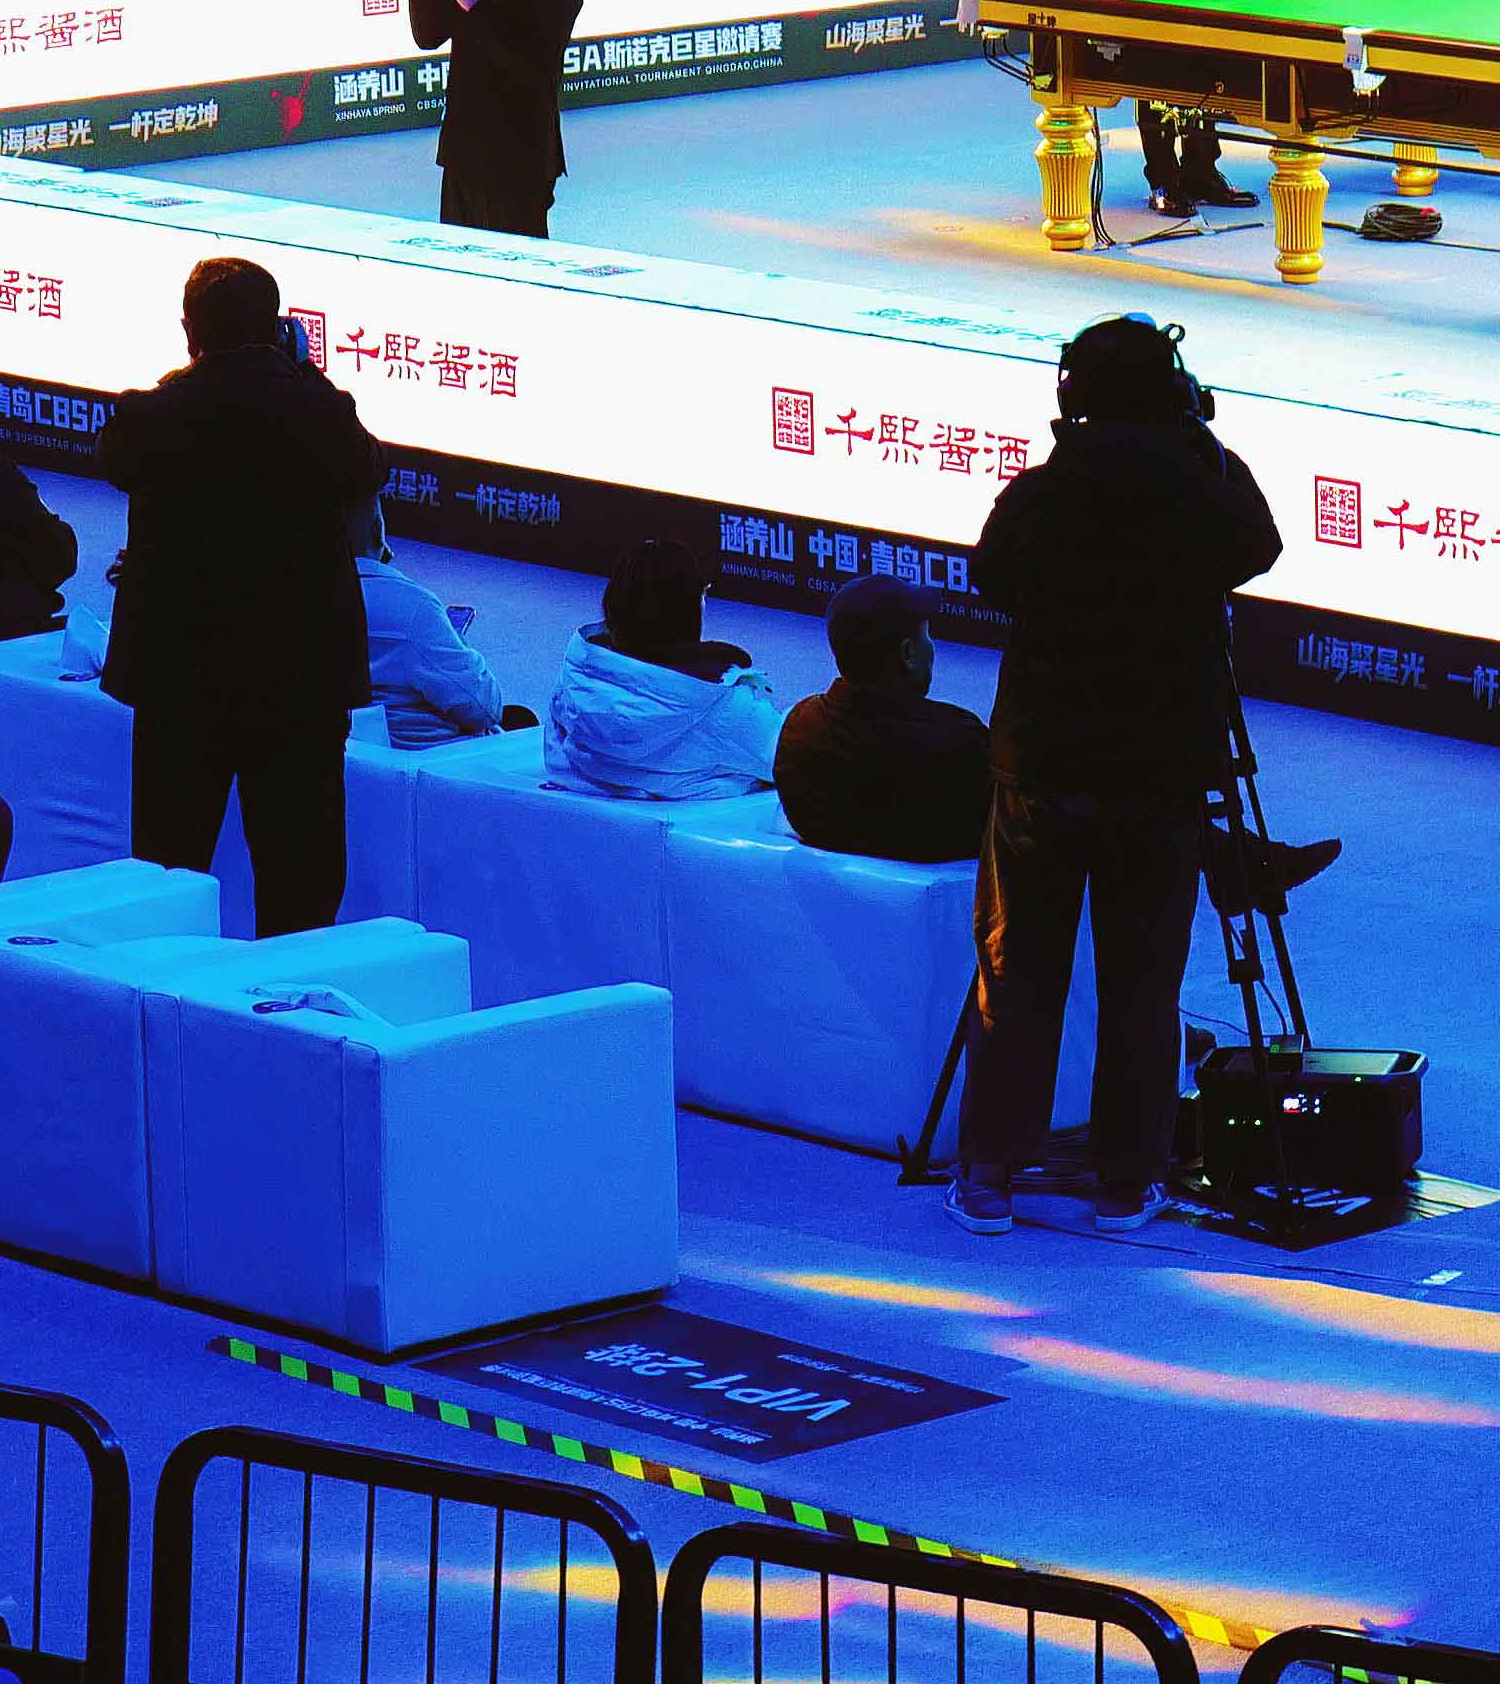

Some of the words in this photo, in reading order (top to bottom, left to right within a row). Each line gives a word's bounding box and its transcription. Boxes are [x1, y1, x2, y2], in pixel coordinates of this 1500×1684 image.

[825, 13, 927, 54] 山海聚星光
[334, 66, 405, 106] 涵养山
[563, 74, 632, 94] INVITATIONAL
[635, 65, 702, 84] TOURNAMENT
[108, 100, 219, 143] 一杆定乾坤
[373, 102, 406, 117] SPRING
[336, 326, 519, 397] 千熙酱酒
[824, 407, 1031, 482] 千熙酱酒
[455, 483, 562, 529] 一杆定乾坤
[719, 513, 795, 563] 涵养山
[1298, 632, 1428, 691] 山海聚星光
